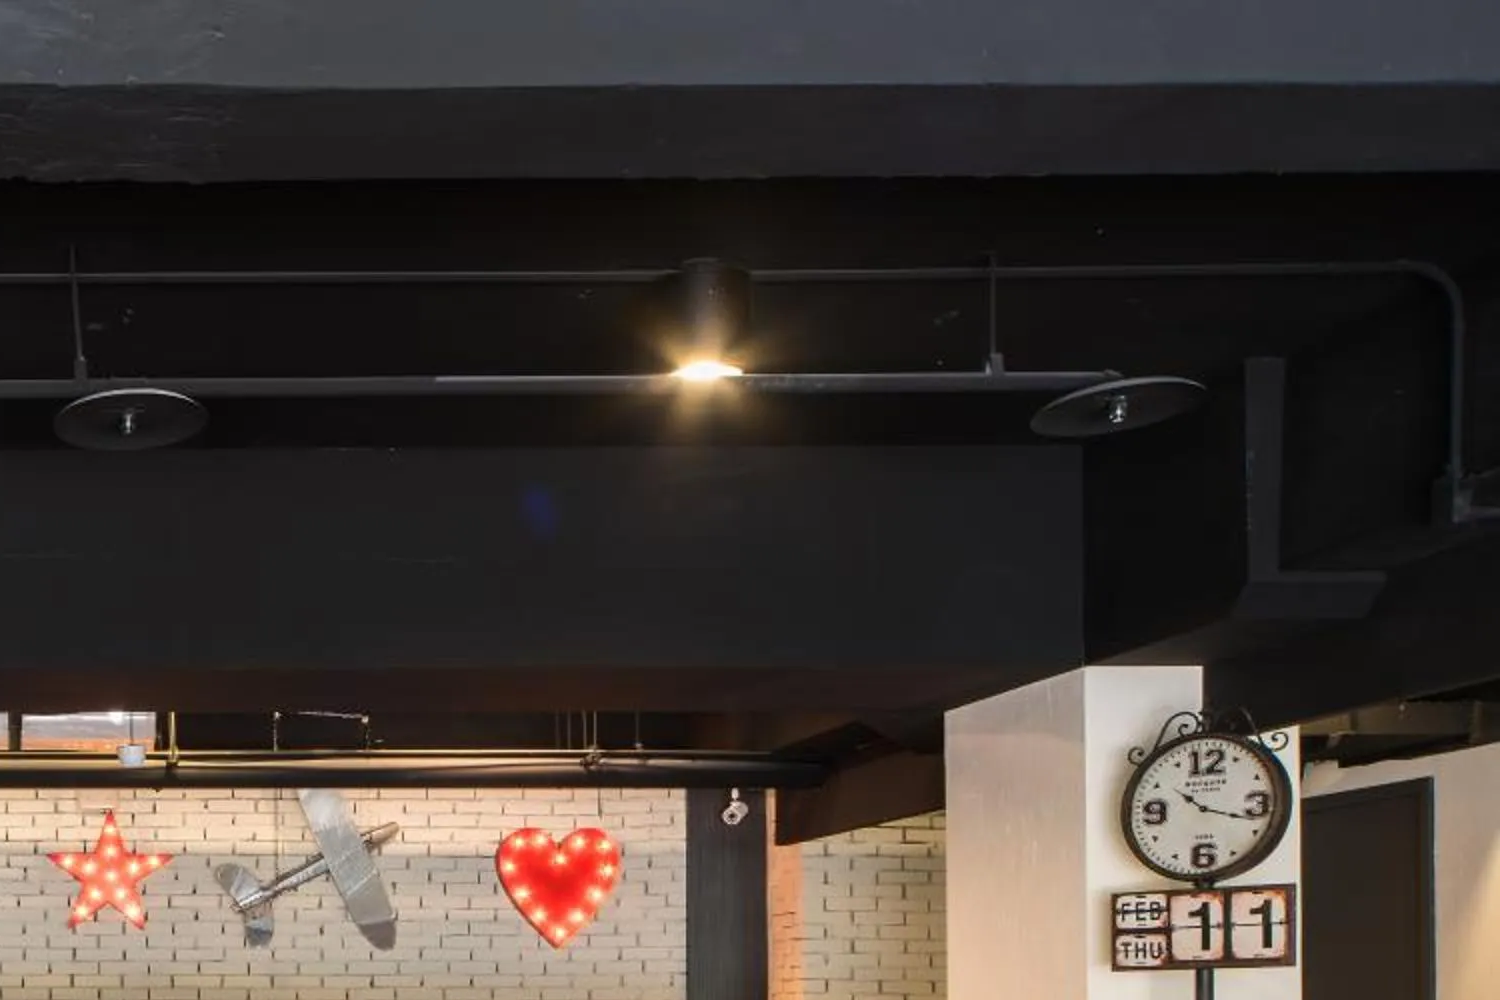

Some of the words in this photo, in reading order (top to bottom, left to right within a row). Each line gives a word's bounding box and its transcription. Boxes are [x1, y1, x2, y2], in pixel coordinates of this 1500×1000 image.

[1188, 749, 1226, 778] 12
[1143, 799, 1167, 825] 9
[1245, 791, 1269, 817] 3
[1190, 842, 1218, 869] 6
[1121, 901, 1161, 922] FEB
[1249, 899, 1273, 949] 1
[1188, 901, 1211, 951] 1
[1120, 941, 1162, 959] THU
